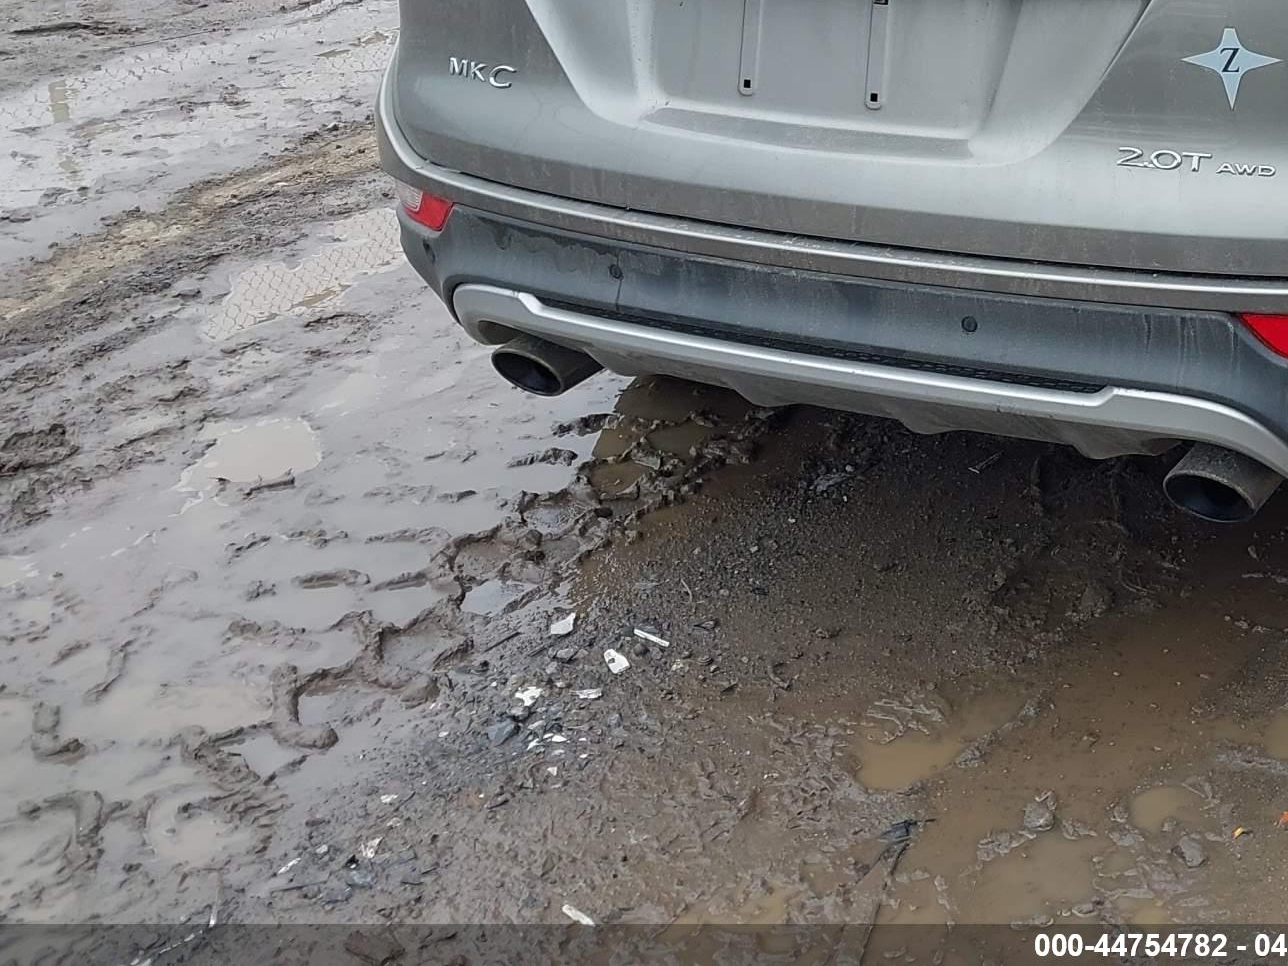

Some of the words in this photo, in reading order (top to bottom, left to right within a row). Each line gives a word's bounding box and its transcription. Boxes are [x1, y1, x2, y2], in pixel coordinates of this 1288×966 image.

[449, 56, 517, 89] MKC
[1220, 47, 1240, 73] Z
[1116, 146, 1212, 172] 2.0T
[1215, 162, 1277, 177] AWD
